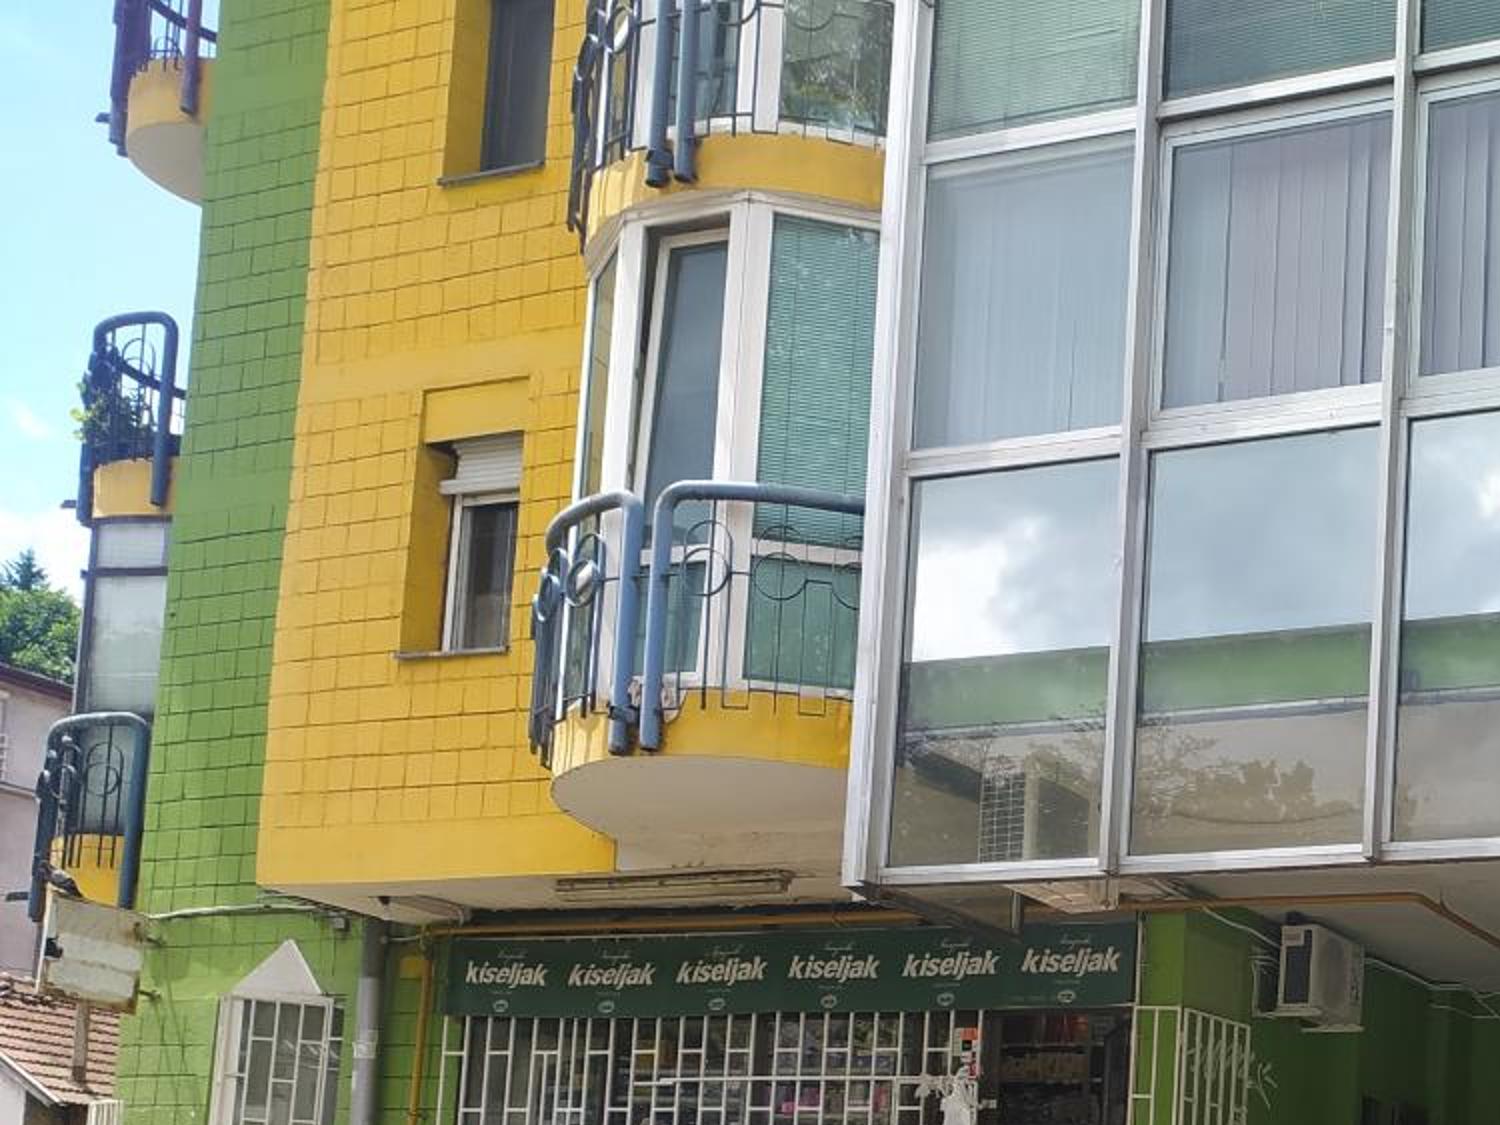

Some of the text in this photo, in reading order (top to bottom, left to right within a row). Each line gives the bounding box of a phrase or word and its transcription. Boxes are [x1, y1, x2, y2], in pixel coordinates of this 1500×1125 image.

[465, 961, 548, 989] kiseljak
[568, 962, 656, 990] kiseljak
[676, 956, 768, 985] kiseljak
[788, 954, 881, 983] kiseljak
[902, 950, 1000, 980] kiseljak
[1021, 946, 1121, 977] kiseljak
